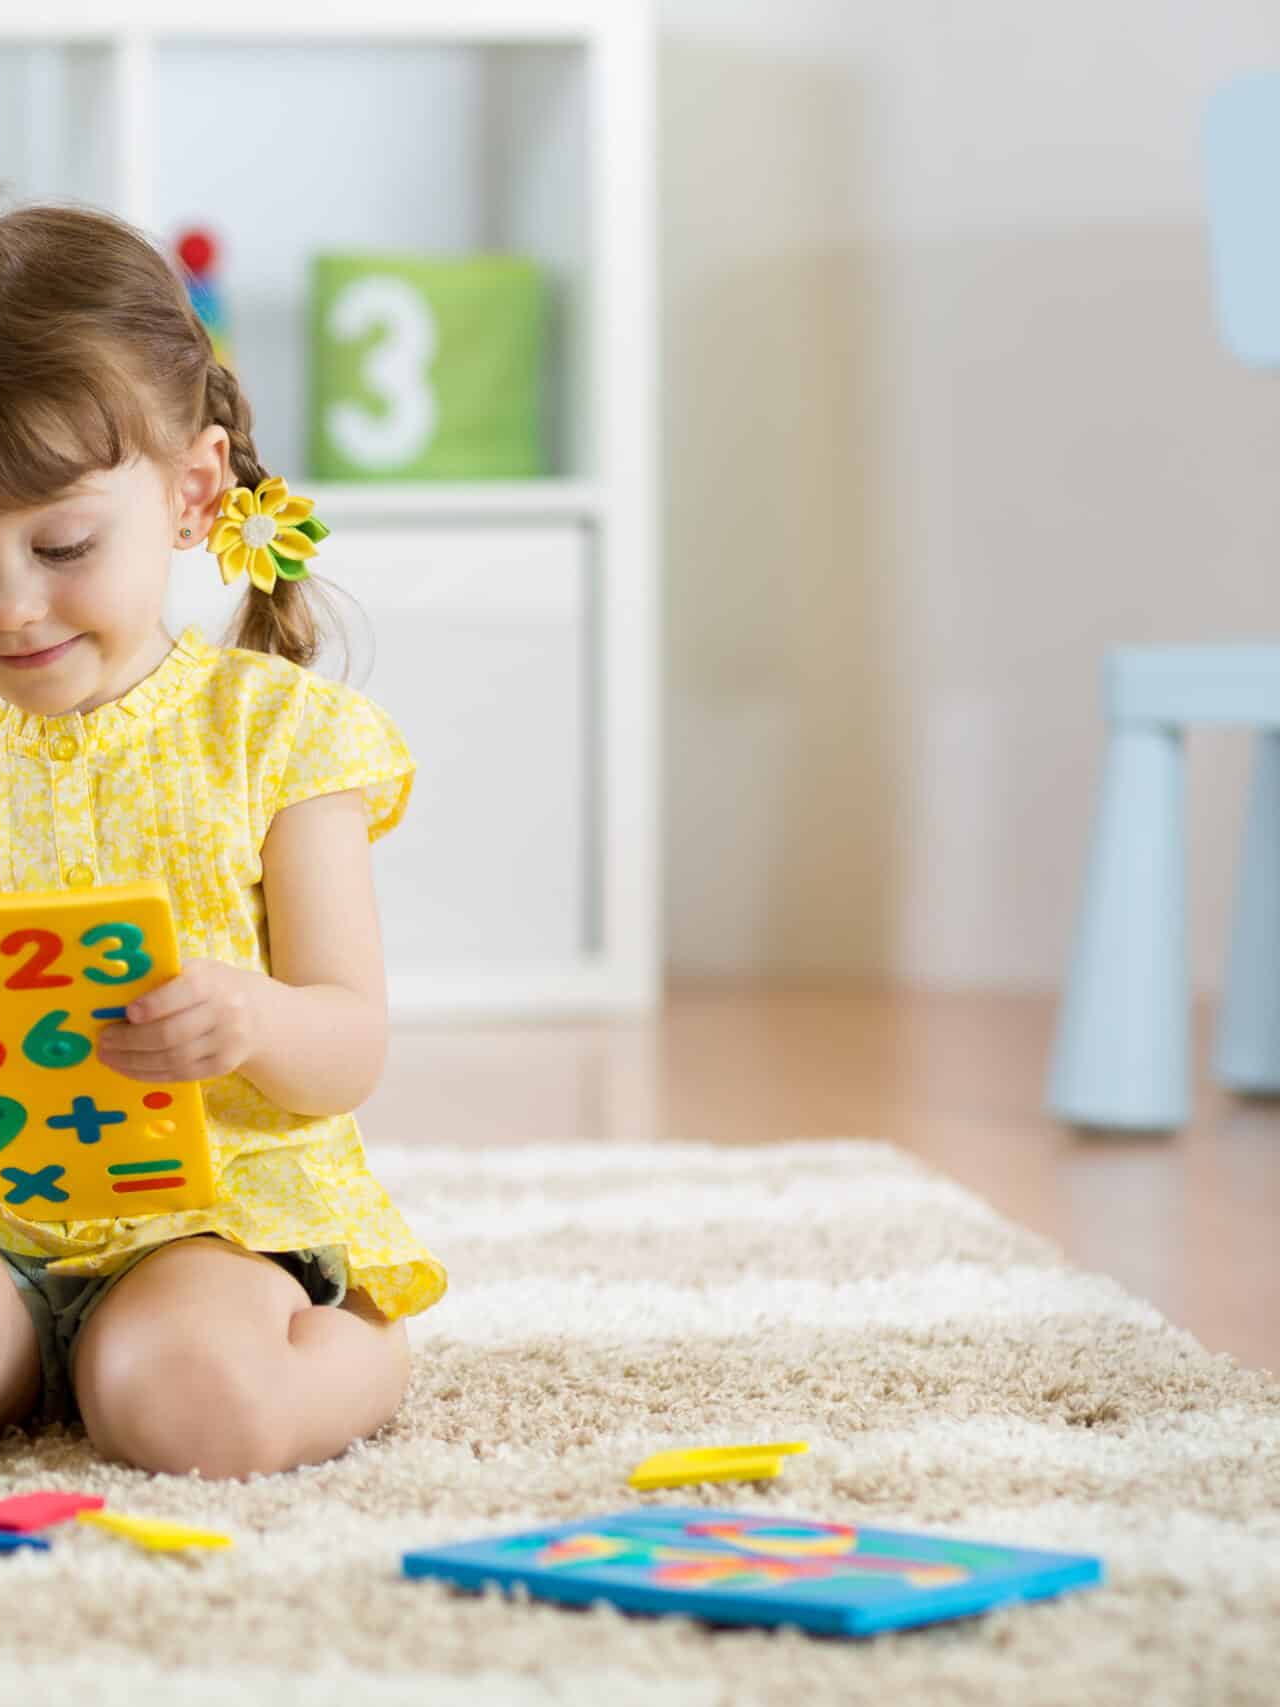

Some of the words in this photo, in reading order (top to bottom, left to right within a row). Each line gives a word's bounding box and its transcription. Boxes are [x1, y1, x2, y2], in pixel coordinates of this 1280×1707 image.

[327, 276, 437, 469] 3
[0, 928, 73, 990] 2
[80, 922, 152, 985] 3
[22, 1009, 92, 1069] 6
